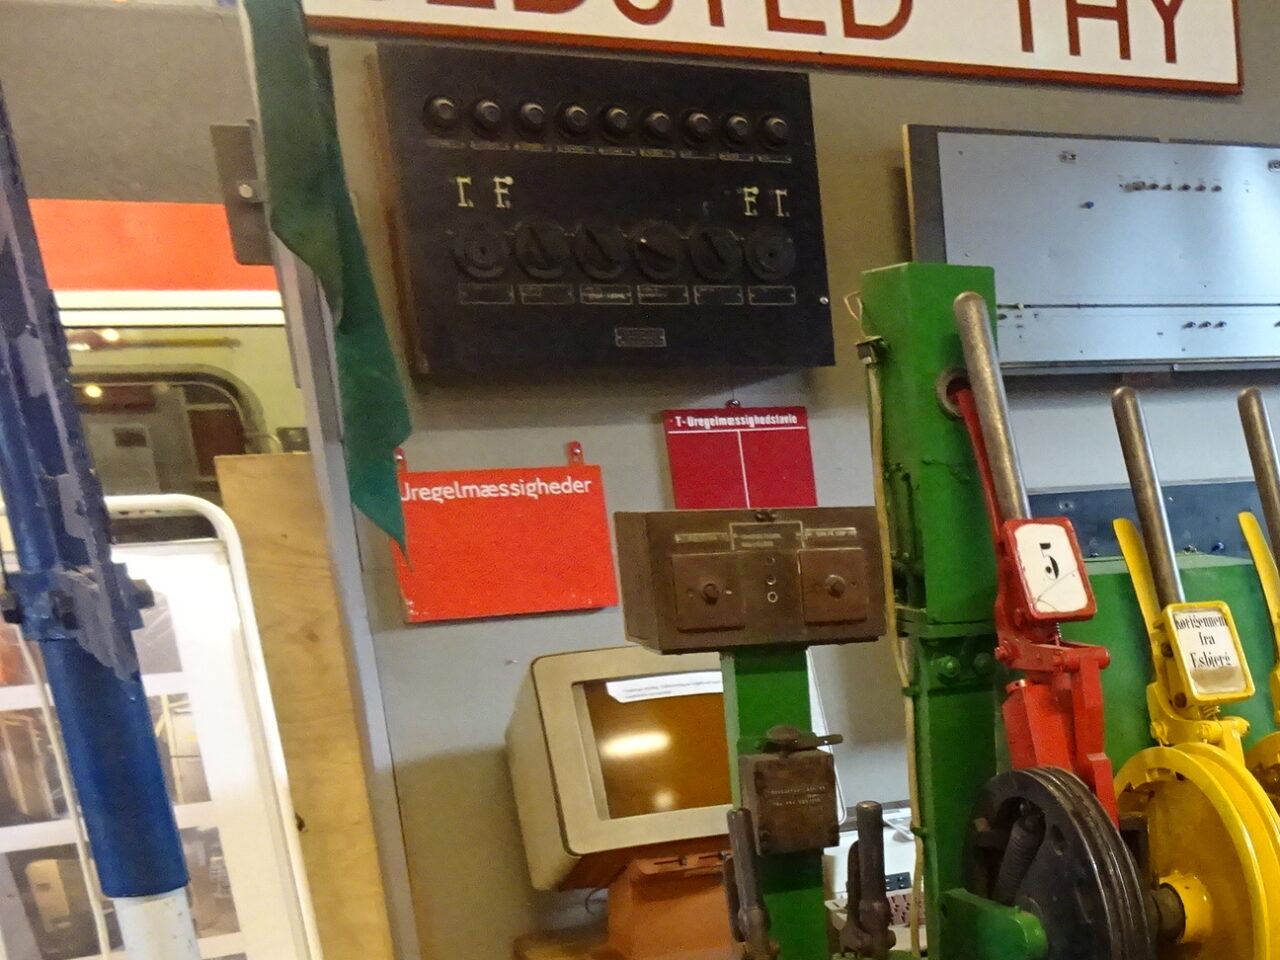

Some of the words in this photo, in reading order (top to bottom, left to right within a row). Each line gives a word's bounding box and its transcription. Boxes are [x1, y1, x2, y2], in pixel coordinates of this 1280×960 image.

[1039, 542, 1060, 580] 5
[1198, 631, 1216, 646] fra
[1190, 651, 1232, 669] Esbjerg
